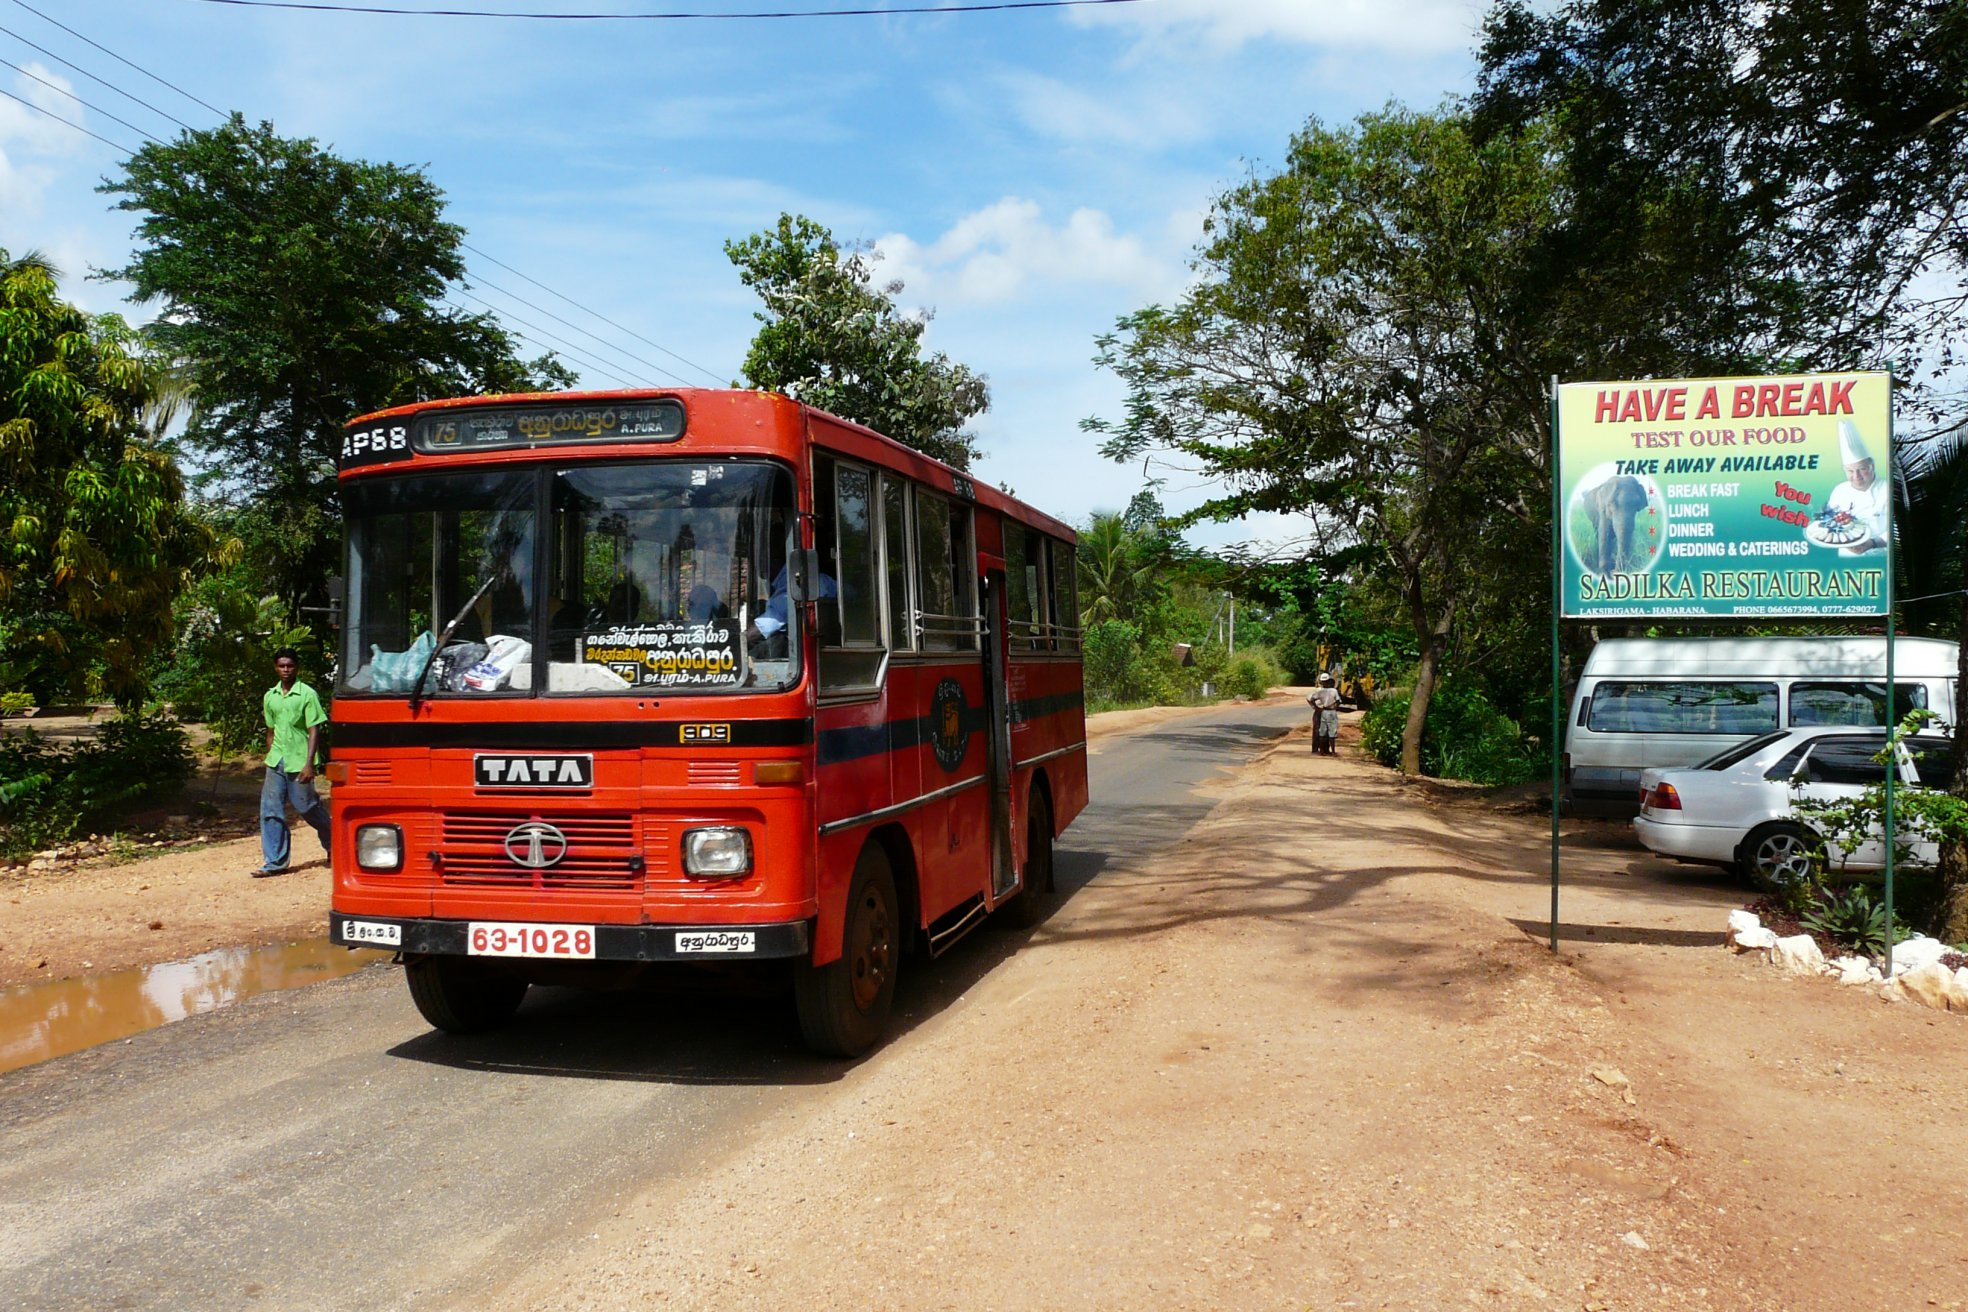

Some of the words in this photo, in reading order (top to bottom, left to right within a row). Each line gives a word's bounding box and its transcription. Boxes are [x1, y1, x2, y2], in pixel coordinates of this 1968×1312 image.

[1595, 387, 1688, 423] HAVE
[1695, 385, 1720, 419] A
[1731, 380, 1857, 418] BREAK
[434, 422, 456, 443] 75
[518, 409, 616, 438] අනුරාධපුර
[621, 422, 663, 433] A.PURA
[341, 426, 406, 459] AP68
[1631, 430, 1684, 449] TEST
[1689, 429, 1736, 446] OUR
[1743, 427, 1806, 445] FOOD
[1615, 459, 1659, 476] TAKE
[1664, 457, 1716, 473] AWAY
[1720, 454, 1819, 472] AVAILABLE
[1667, 484, 1708, 498] BREAK
[1710, 483, 1740, 497] FAST
[1775, 481, 1811, 505] You
[1668, 503, 1709, 518] LUNCH
[1760, 503, 1810, 528] wish
[1668, 523, 1714, 537] DINNER
[1668, 543, 1726, 557] WEDDING
[1728, 542, 1737, 556] &
[1739, 541, 1809, 556] CATERINGS
[1580, 573, 1696, 600] SADILKA
[1702, 571, 1882, 599] RESTAURANT
[1579, 607, 1645, 615] LAKSIRIGAMA
[1733, 606, 1765, 614] PHONE
[1822, 605, 1878, 613] 0777-629027
[682, 724, 730, 741] 909
[482, 759, 584, 782] TATA
[473, 928, 592, 955] 63-1028
